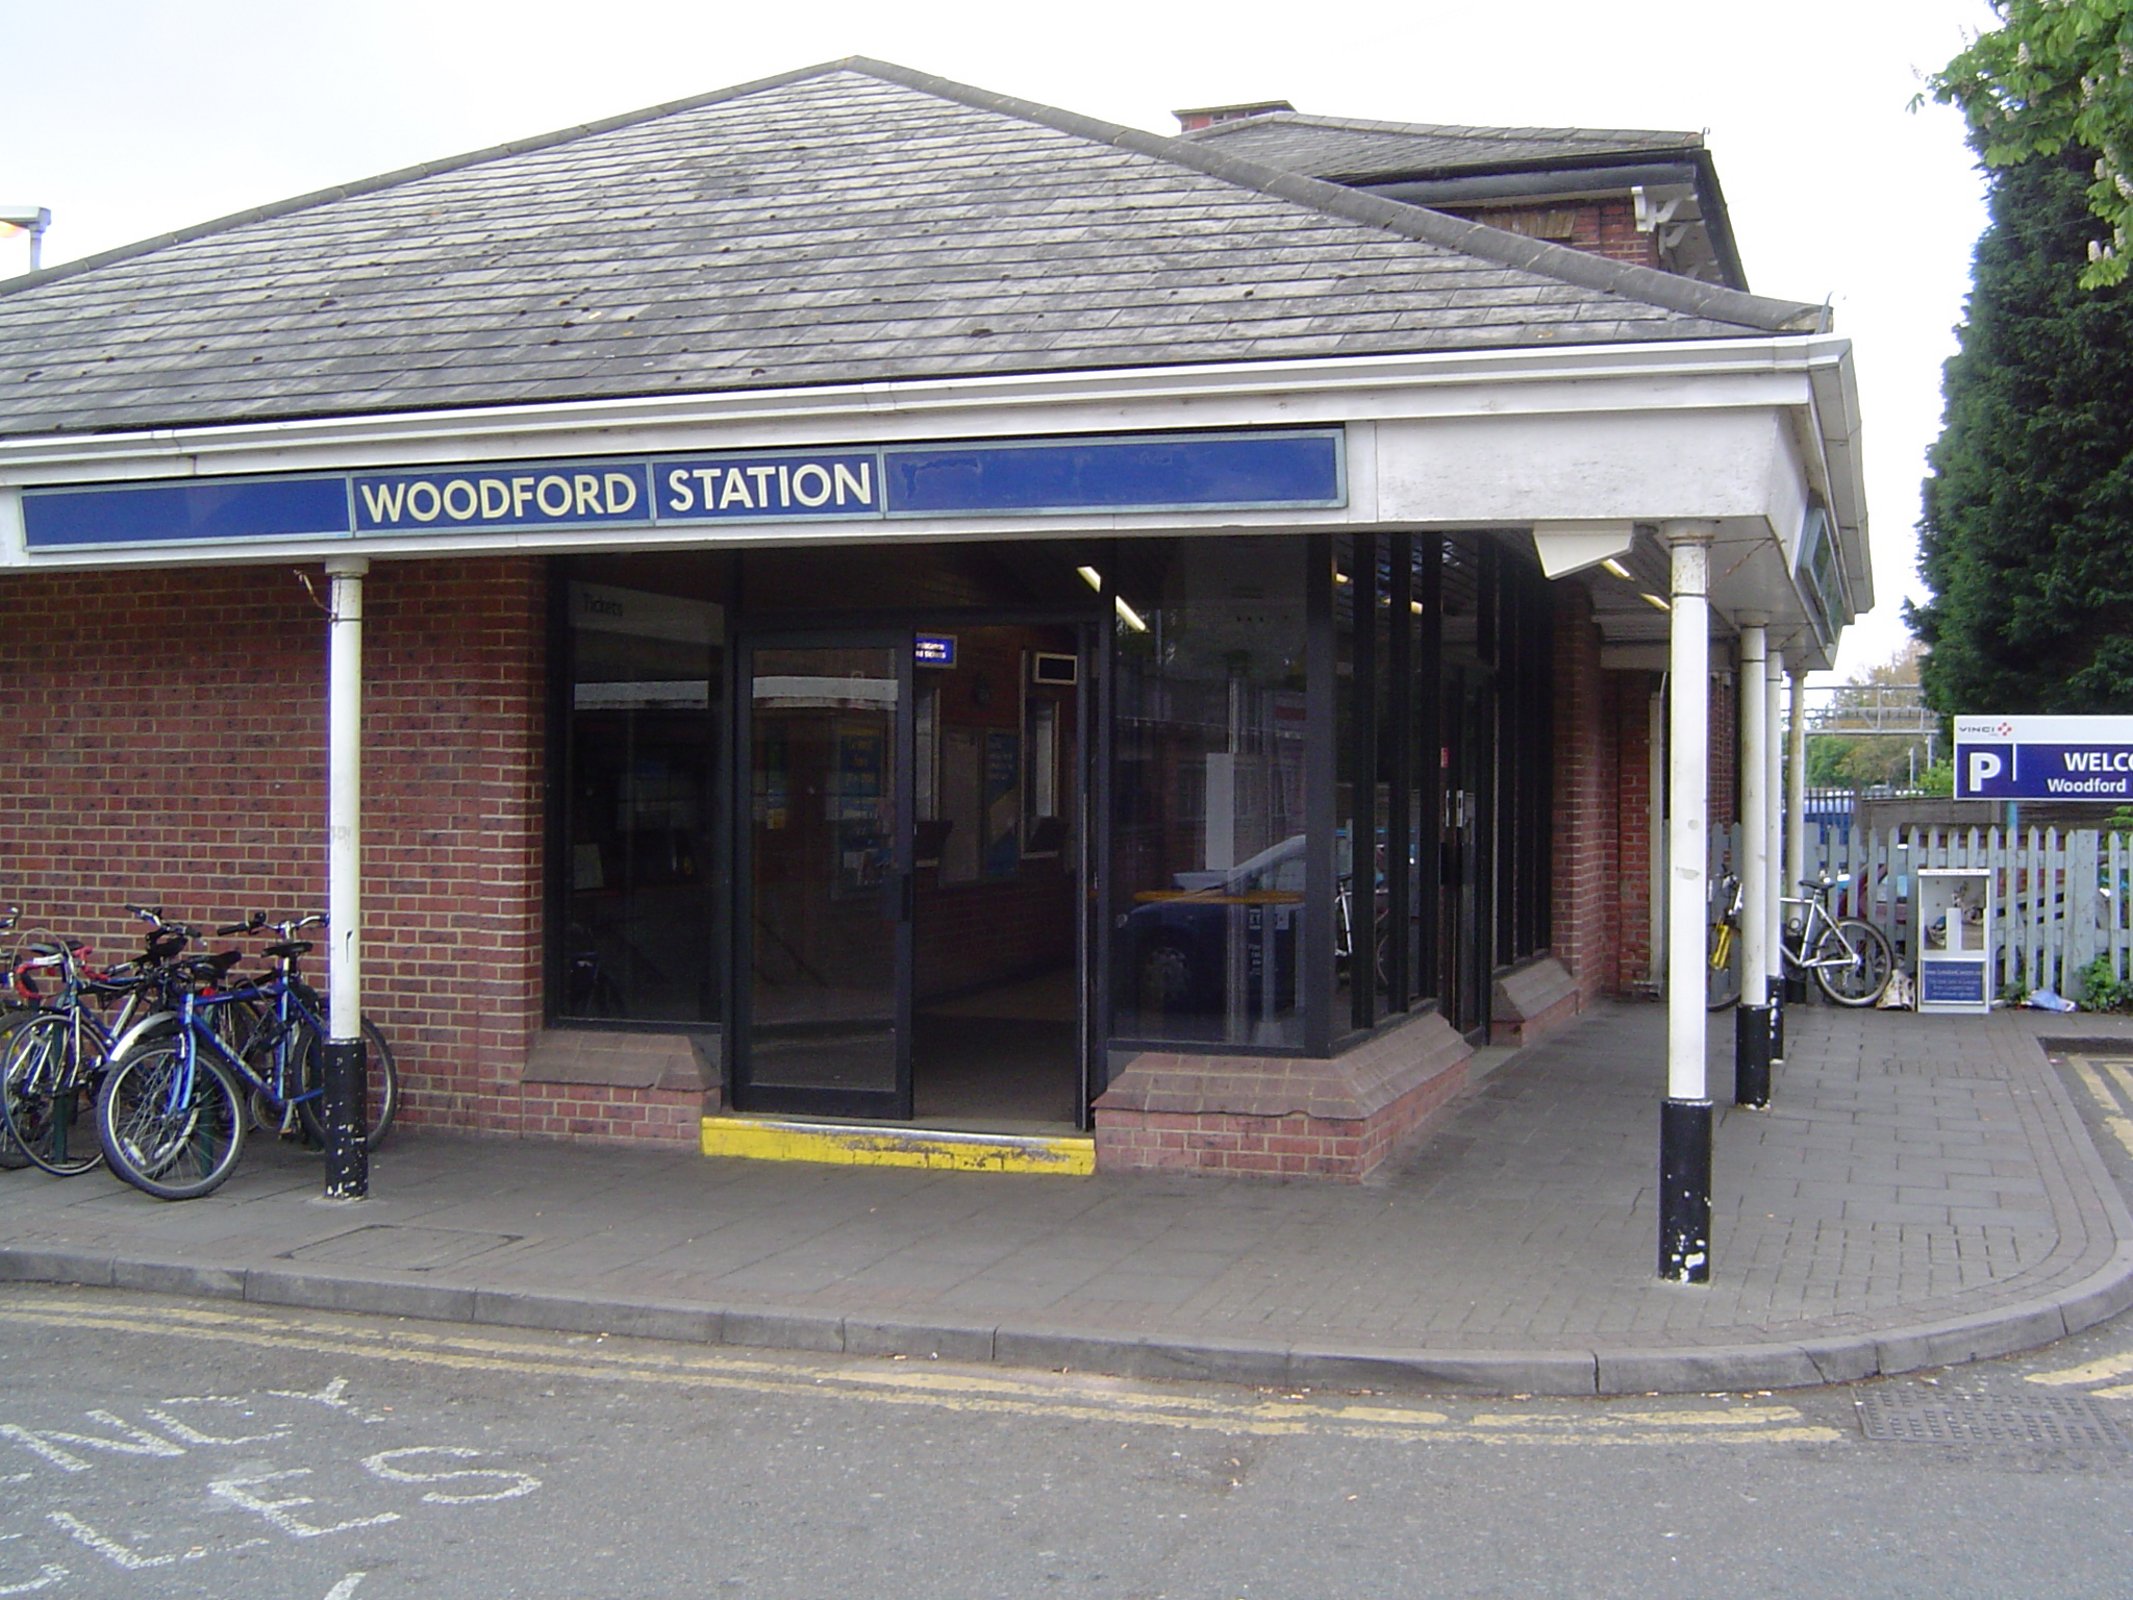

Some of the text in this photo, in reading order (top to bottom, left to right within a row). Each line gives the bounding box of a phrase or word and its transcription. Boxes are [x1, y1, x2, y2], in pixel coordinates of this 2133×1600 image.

[361, 462, 872, 523] WOODFORD STATION
[1969, 752, 2001, 792] P
[2063, 752, 2133, 772] WELC
[2047, 778, 2126, 793] Woodford
